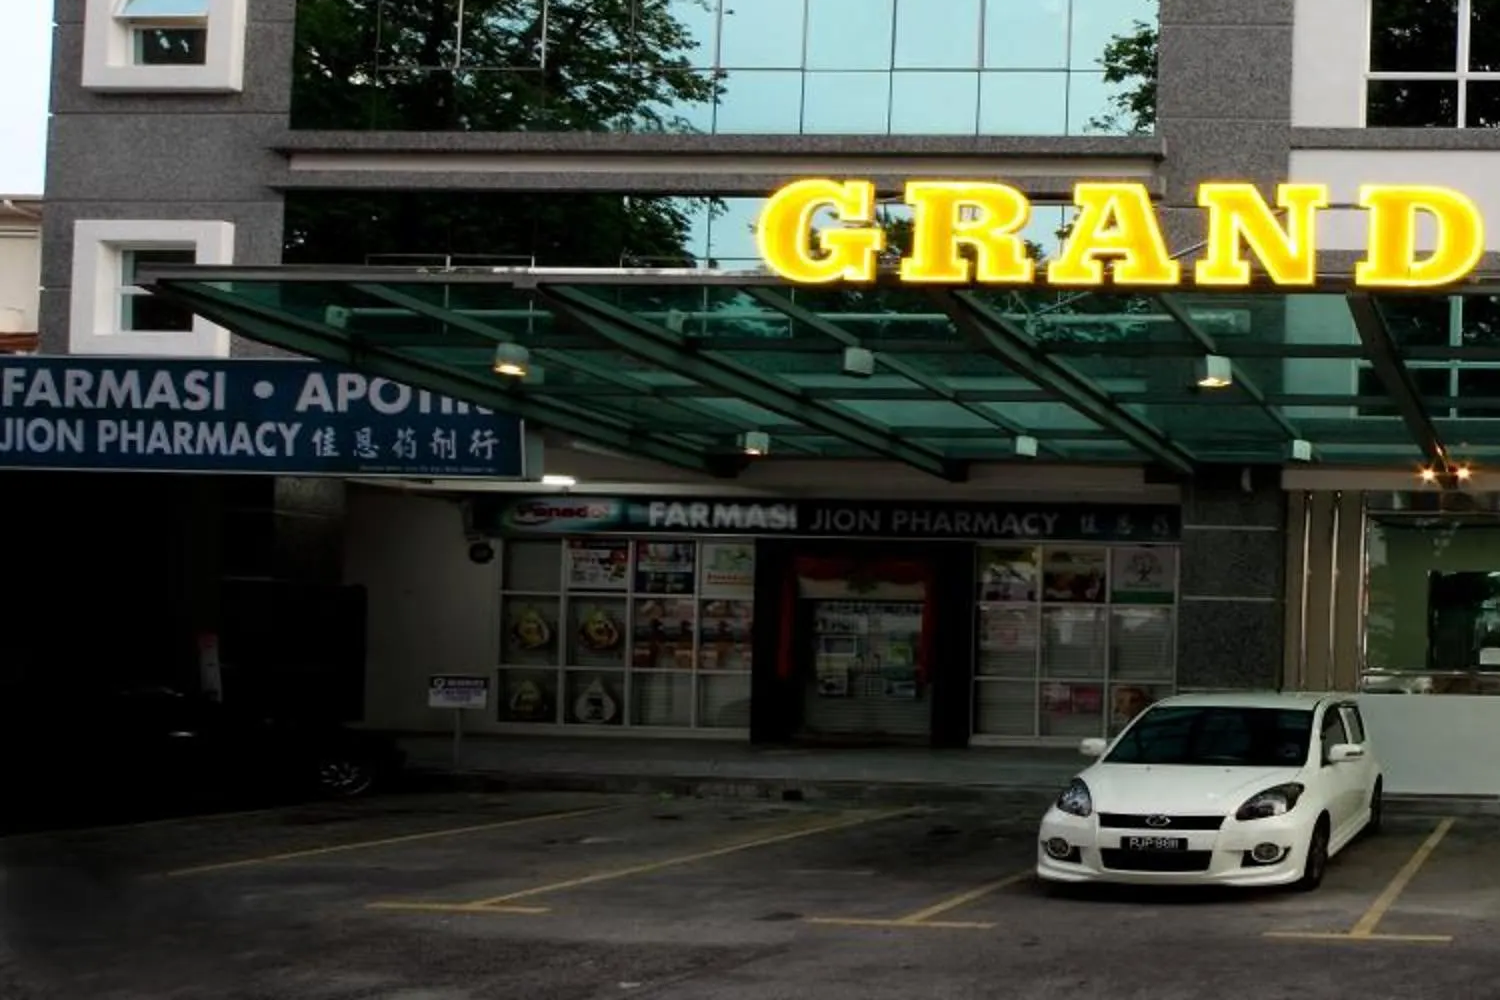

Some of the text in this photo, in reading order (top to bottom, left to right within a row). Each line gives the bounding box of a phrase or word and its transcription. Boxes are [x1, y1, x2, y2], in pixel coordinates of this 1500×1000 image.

[756, 178, 1486, 289] GRAND
[2, 367, 495, 415] FARMASI APO
[0, 417, 302, 457] JION PHARMACY
[648, 501, 799, 530] FARMASI
[808, 508, 1060, 536] JION PHARMACY
